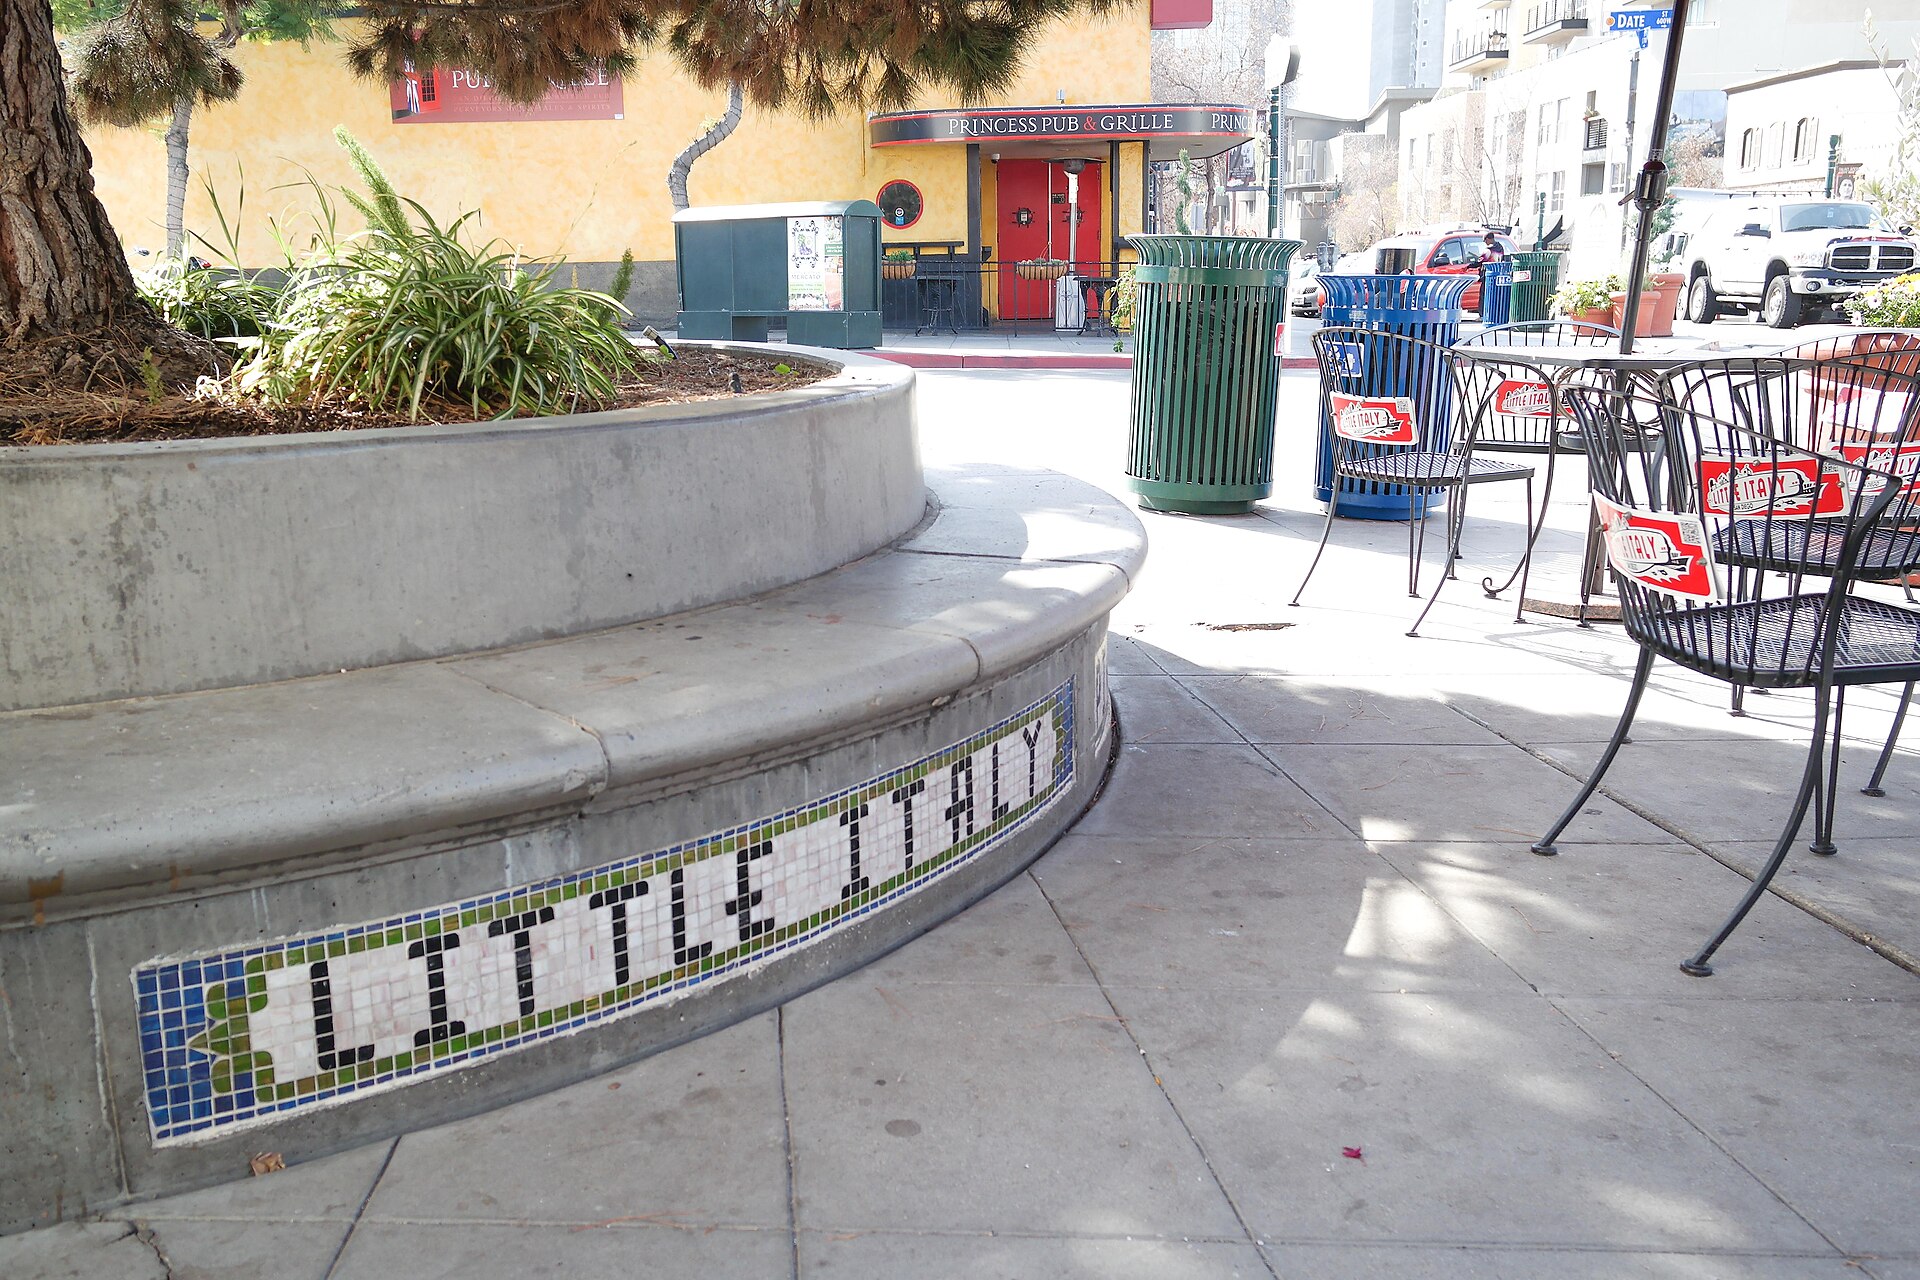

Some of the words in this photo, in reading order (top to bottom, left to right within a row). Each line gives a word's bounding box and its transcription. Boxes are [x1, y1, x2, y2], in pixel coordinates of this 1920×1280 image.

[1618, 14, 1645, 28] DATE
[1661, 10, 1668, 18] ST
[948, 117, 1038, 136] PRINCESS
[1041, 116, 1080, 133] PUB
[1083, 115, 1097, 131] &
[1100, 113, 1174, 133] GRILLE
[1506, 393, 1527, 408] LITTLE
[1529, 391, 1549, 406] ITAL
[1357, 411, 1380, 428] ITALY
[1712, 482, 1741, 505] LITTE
[310, 840, 775, 1071] LITTLE
[839, 719, 1042, 900] ITALY
